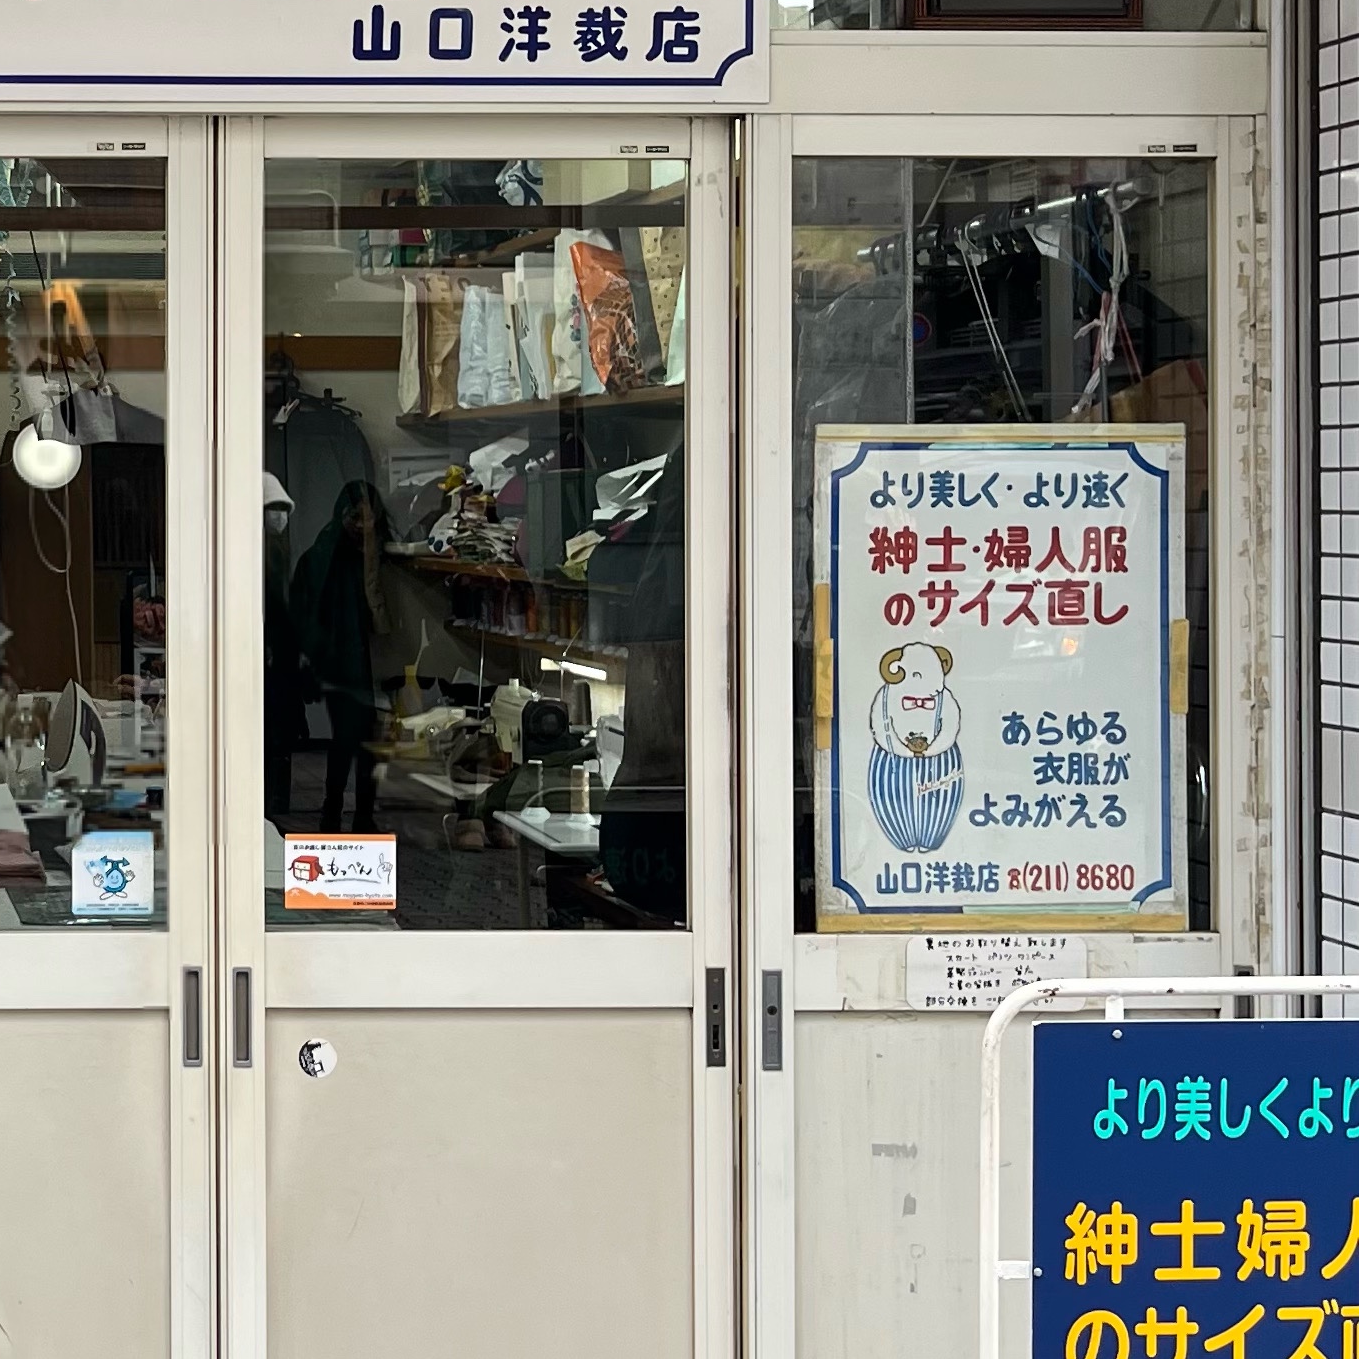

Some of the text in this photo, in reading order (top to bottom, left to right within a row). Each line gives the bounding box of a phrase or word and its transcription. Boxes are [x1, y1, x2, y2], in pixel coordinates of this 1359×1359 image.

[352, 5, 700, 62] 山口洋裁店
[869, 470, 1128, 509] より美しく・より速く
[868, 526, 1129, 575] 紳士・婦人服
[885, 578, 1130, 627] のサイズ直し
[1001, 710, 1128, 746] あらゆる
[1033, 752, 1131, 786] 衣服が
[969, 793, 1128, 828] よみがえる
[876, 862, 1135, 894] 山口洋裁店 (211) 8680
[1065, 1298, 1359, 1359] のサイズ
